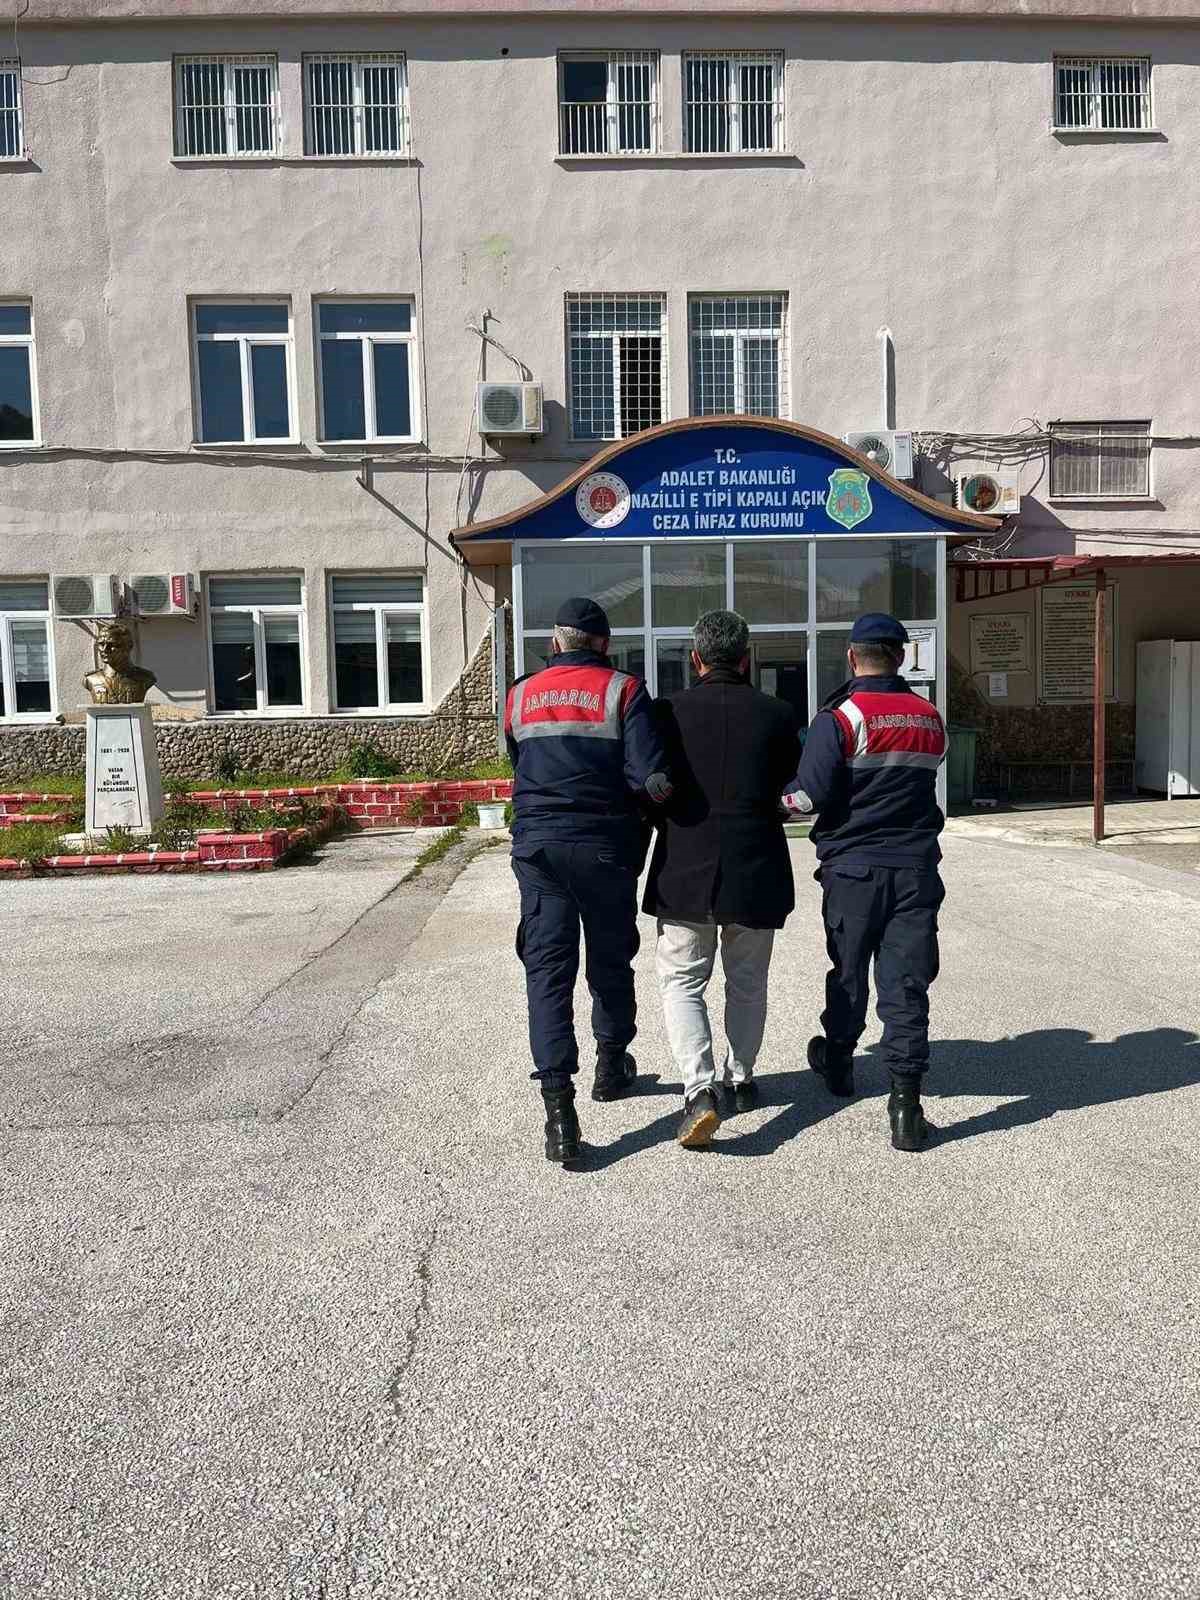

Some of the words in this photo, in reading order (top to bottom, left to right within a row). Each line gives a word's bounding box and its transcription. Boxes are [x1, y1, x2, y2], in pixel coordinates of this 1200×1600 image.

[714, 448, 741, 464] T.C.
[660, 470, 715, 486] ADALET
[719, 466, 796, 486] BAKANLIĞI
[631, 489, 685, 509] NAZİLLİ
[690, 493, 699, 508] E
[703, 488, 732, 508] TİPİ
[736, 491, 787, 507] KAPALI
[791, 490, 826, 510] AÇIK
[652, 514, 690, 530] CEZA
[694, 511, 736, 530] İNFAZ
[740, 512, 805, 529] KURUMU
[524, 688, 600, 714] JANDARMA
[869, 713, 941, 731] JANDARMA
